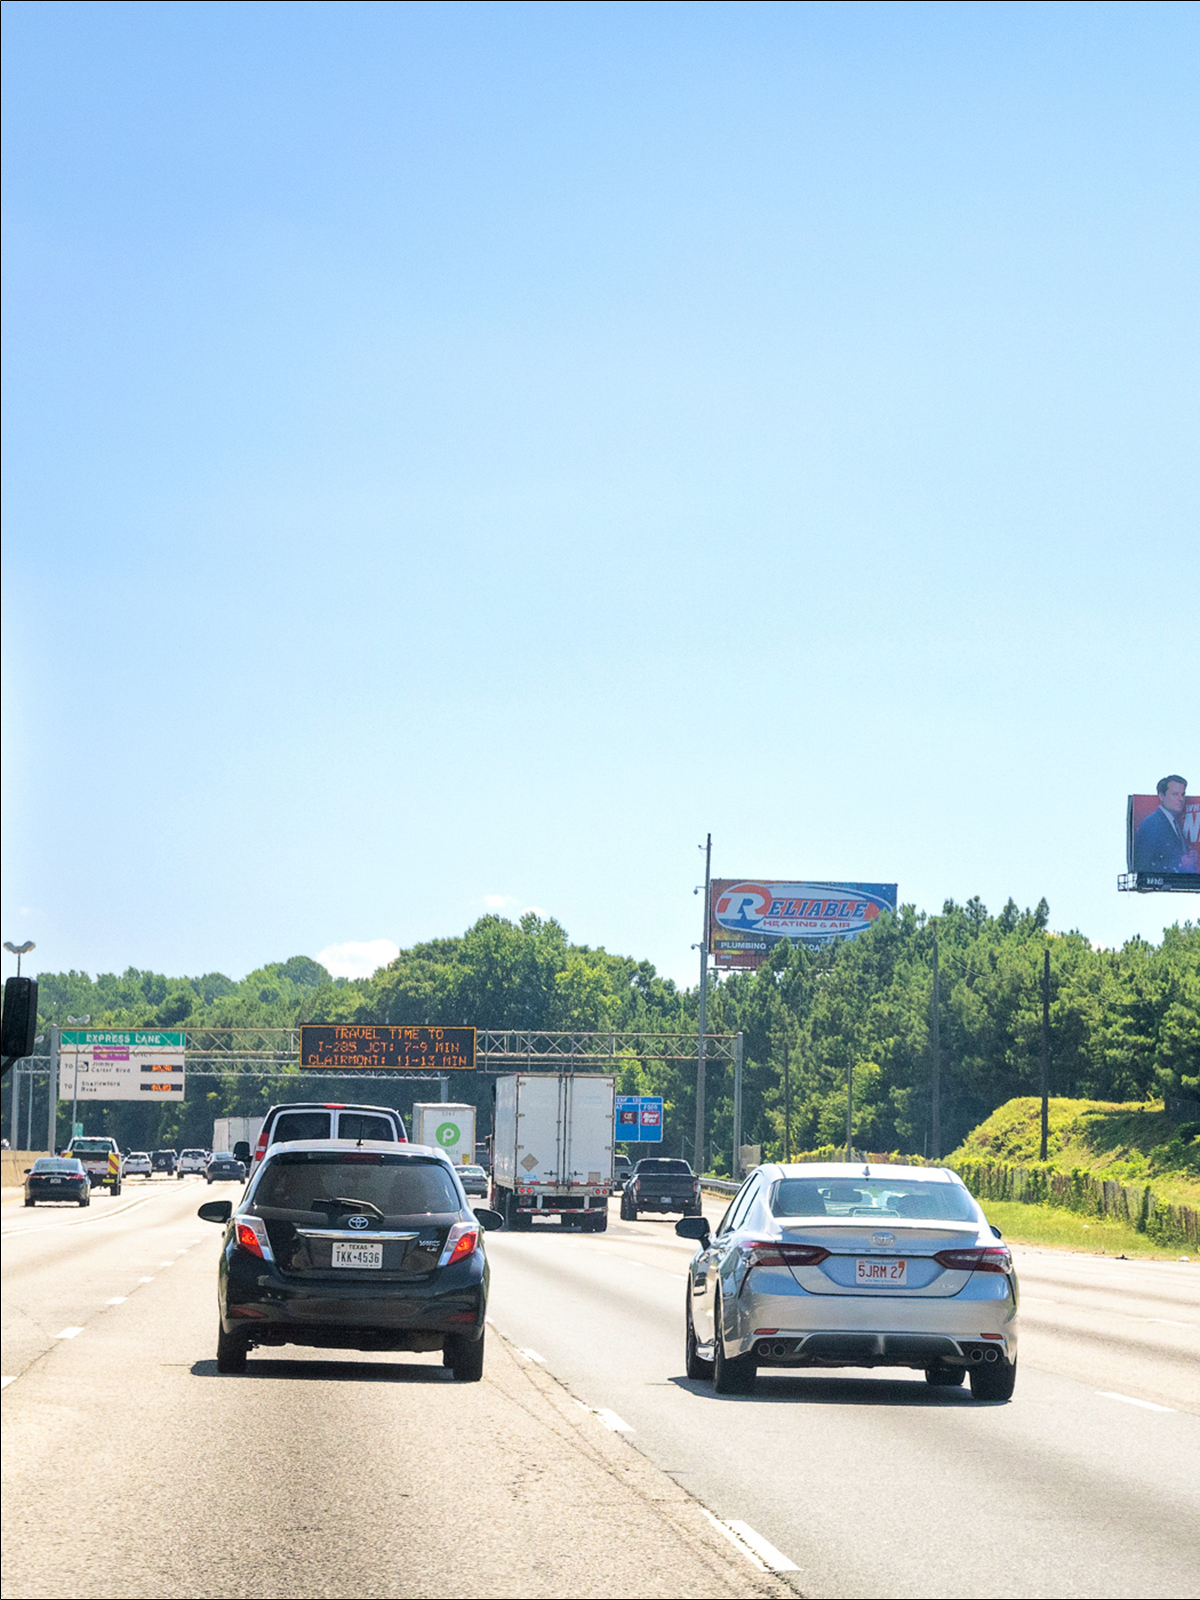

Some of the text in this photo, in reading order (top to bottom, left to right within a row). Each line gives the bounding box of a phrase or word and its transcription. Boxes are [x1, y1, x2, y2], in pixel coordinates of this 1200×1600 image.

[716, 892, 870, 920] RELIABLE
[763, 920, 817, 928] HEATING
[721, 941, 767, 950] PLUMBING
[86, 1034, 161, 1044] EXPRESS LANE
[334, 1028, 444, 1040] TRAVEL TIME TO
[318, 1041, 460, 1053] I-285 JCT: 7-9 MIN
[308, 1054, 386, 1065] CLAIRMONT:
[442, 1056, 467, 1067] MIN
[858, 1264, 905, 1279] 5JRM 27
